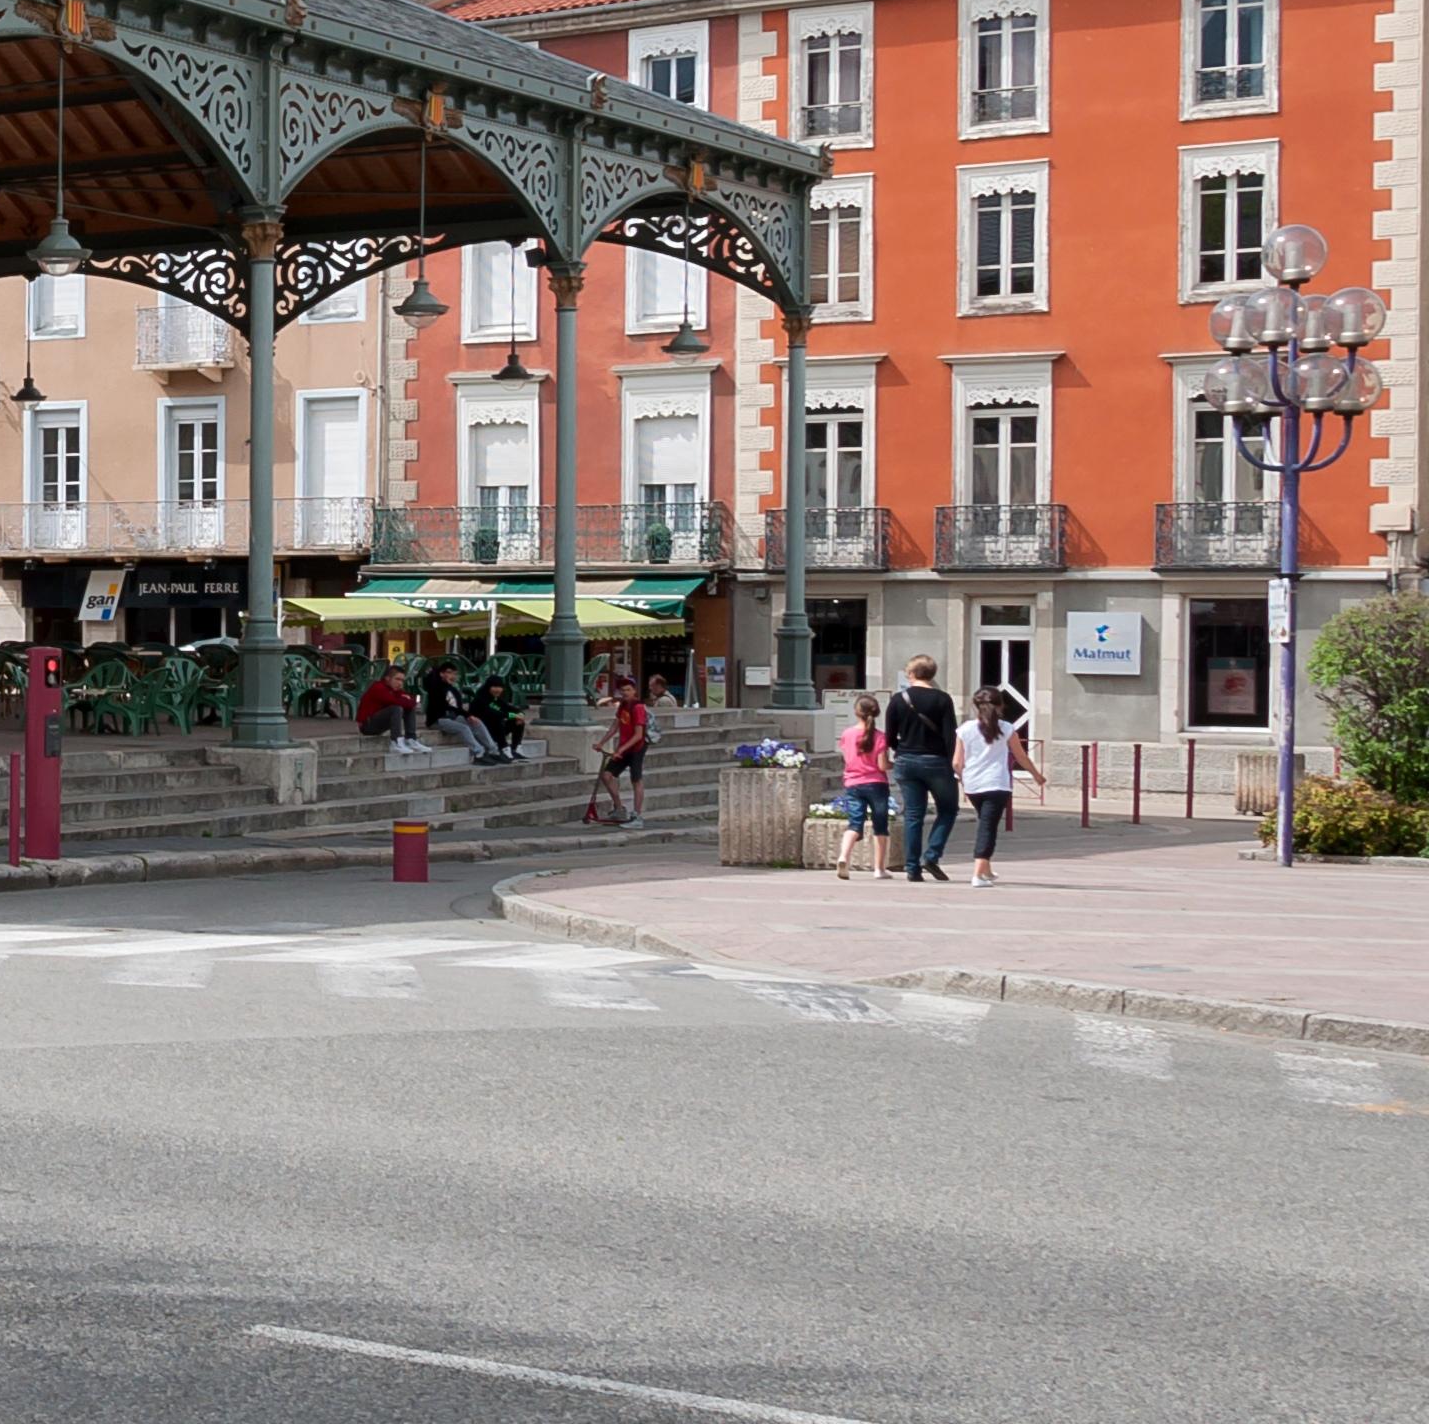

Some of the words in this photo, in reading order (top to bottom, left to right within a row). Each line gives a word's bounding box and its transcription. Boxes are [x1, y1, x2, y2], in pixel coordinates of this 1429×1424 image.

[138, 582, 198, 596] JEAN-PAUL
[204, 582, 239, 594] FERRE
[86, 595, 115, 609] gan
[1073, 647, 1131, 660] Matmut
